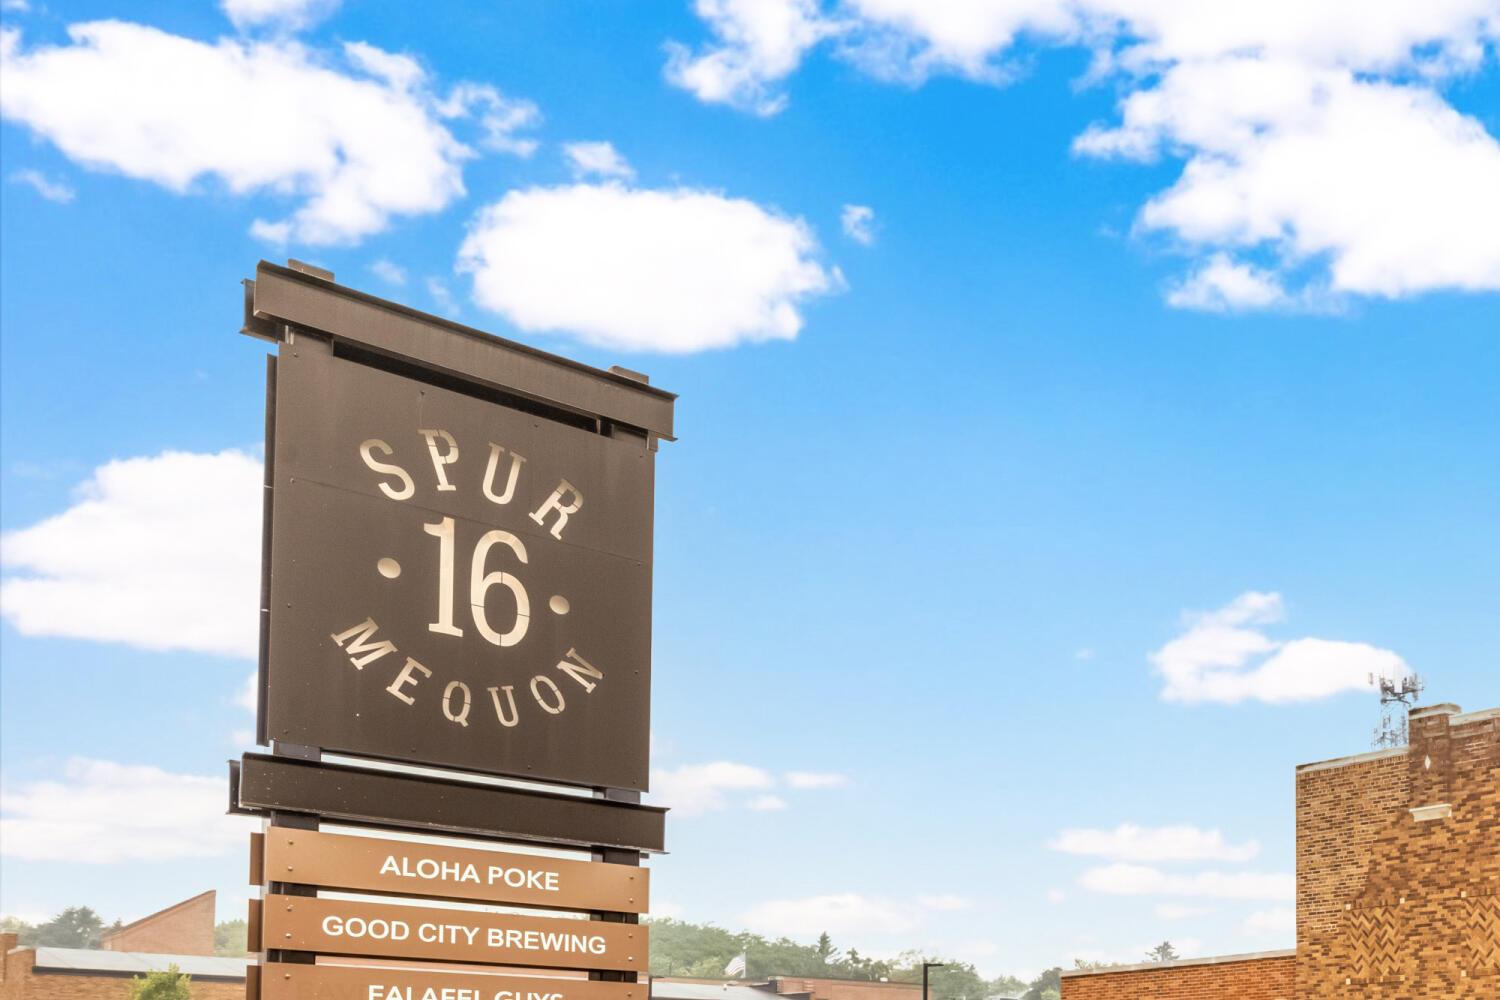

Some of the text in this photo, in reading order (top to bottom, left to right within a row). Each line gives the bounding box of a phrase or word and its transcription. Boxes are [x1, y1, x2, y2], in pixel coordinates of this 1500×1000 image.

[359, 428, 584, 541] SPUR
[422, 515, 532, 648] 16
[330, 616, 604, 728] MEQUON
[379, 855, 560, 891] ALOHA POKE
[321, 915, 607, 955] GOOD CITY BREWING
